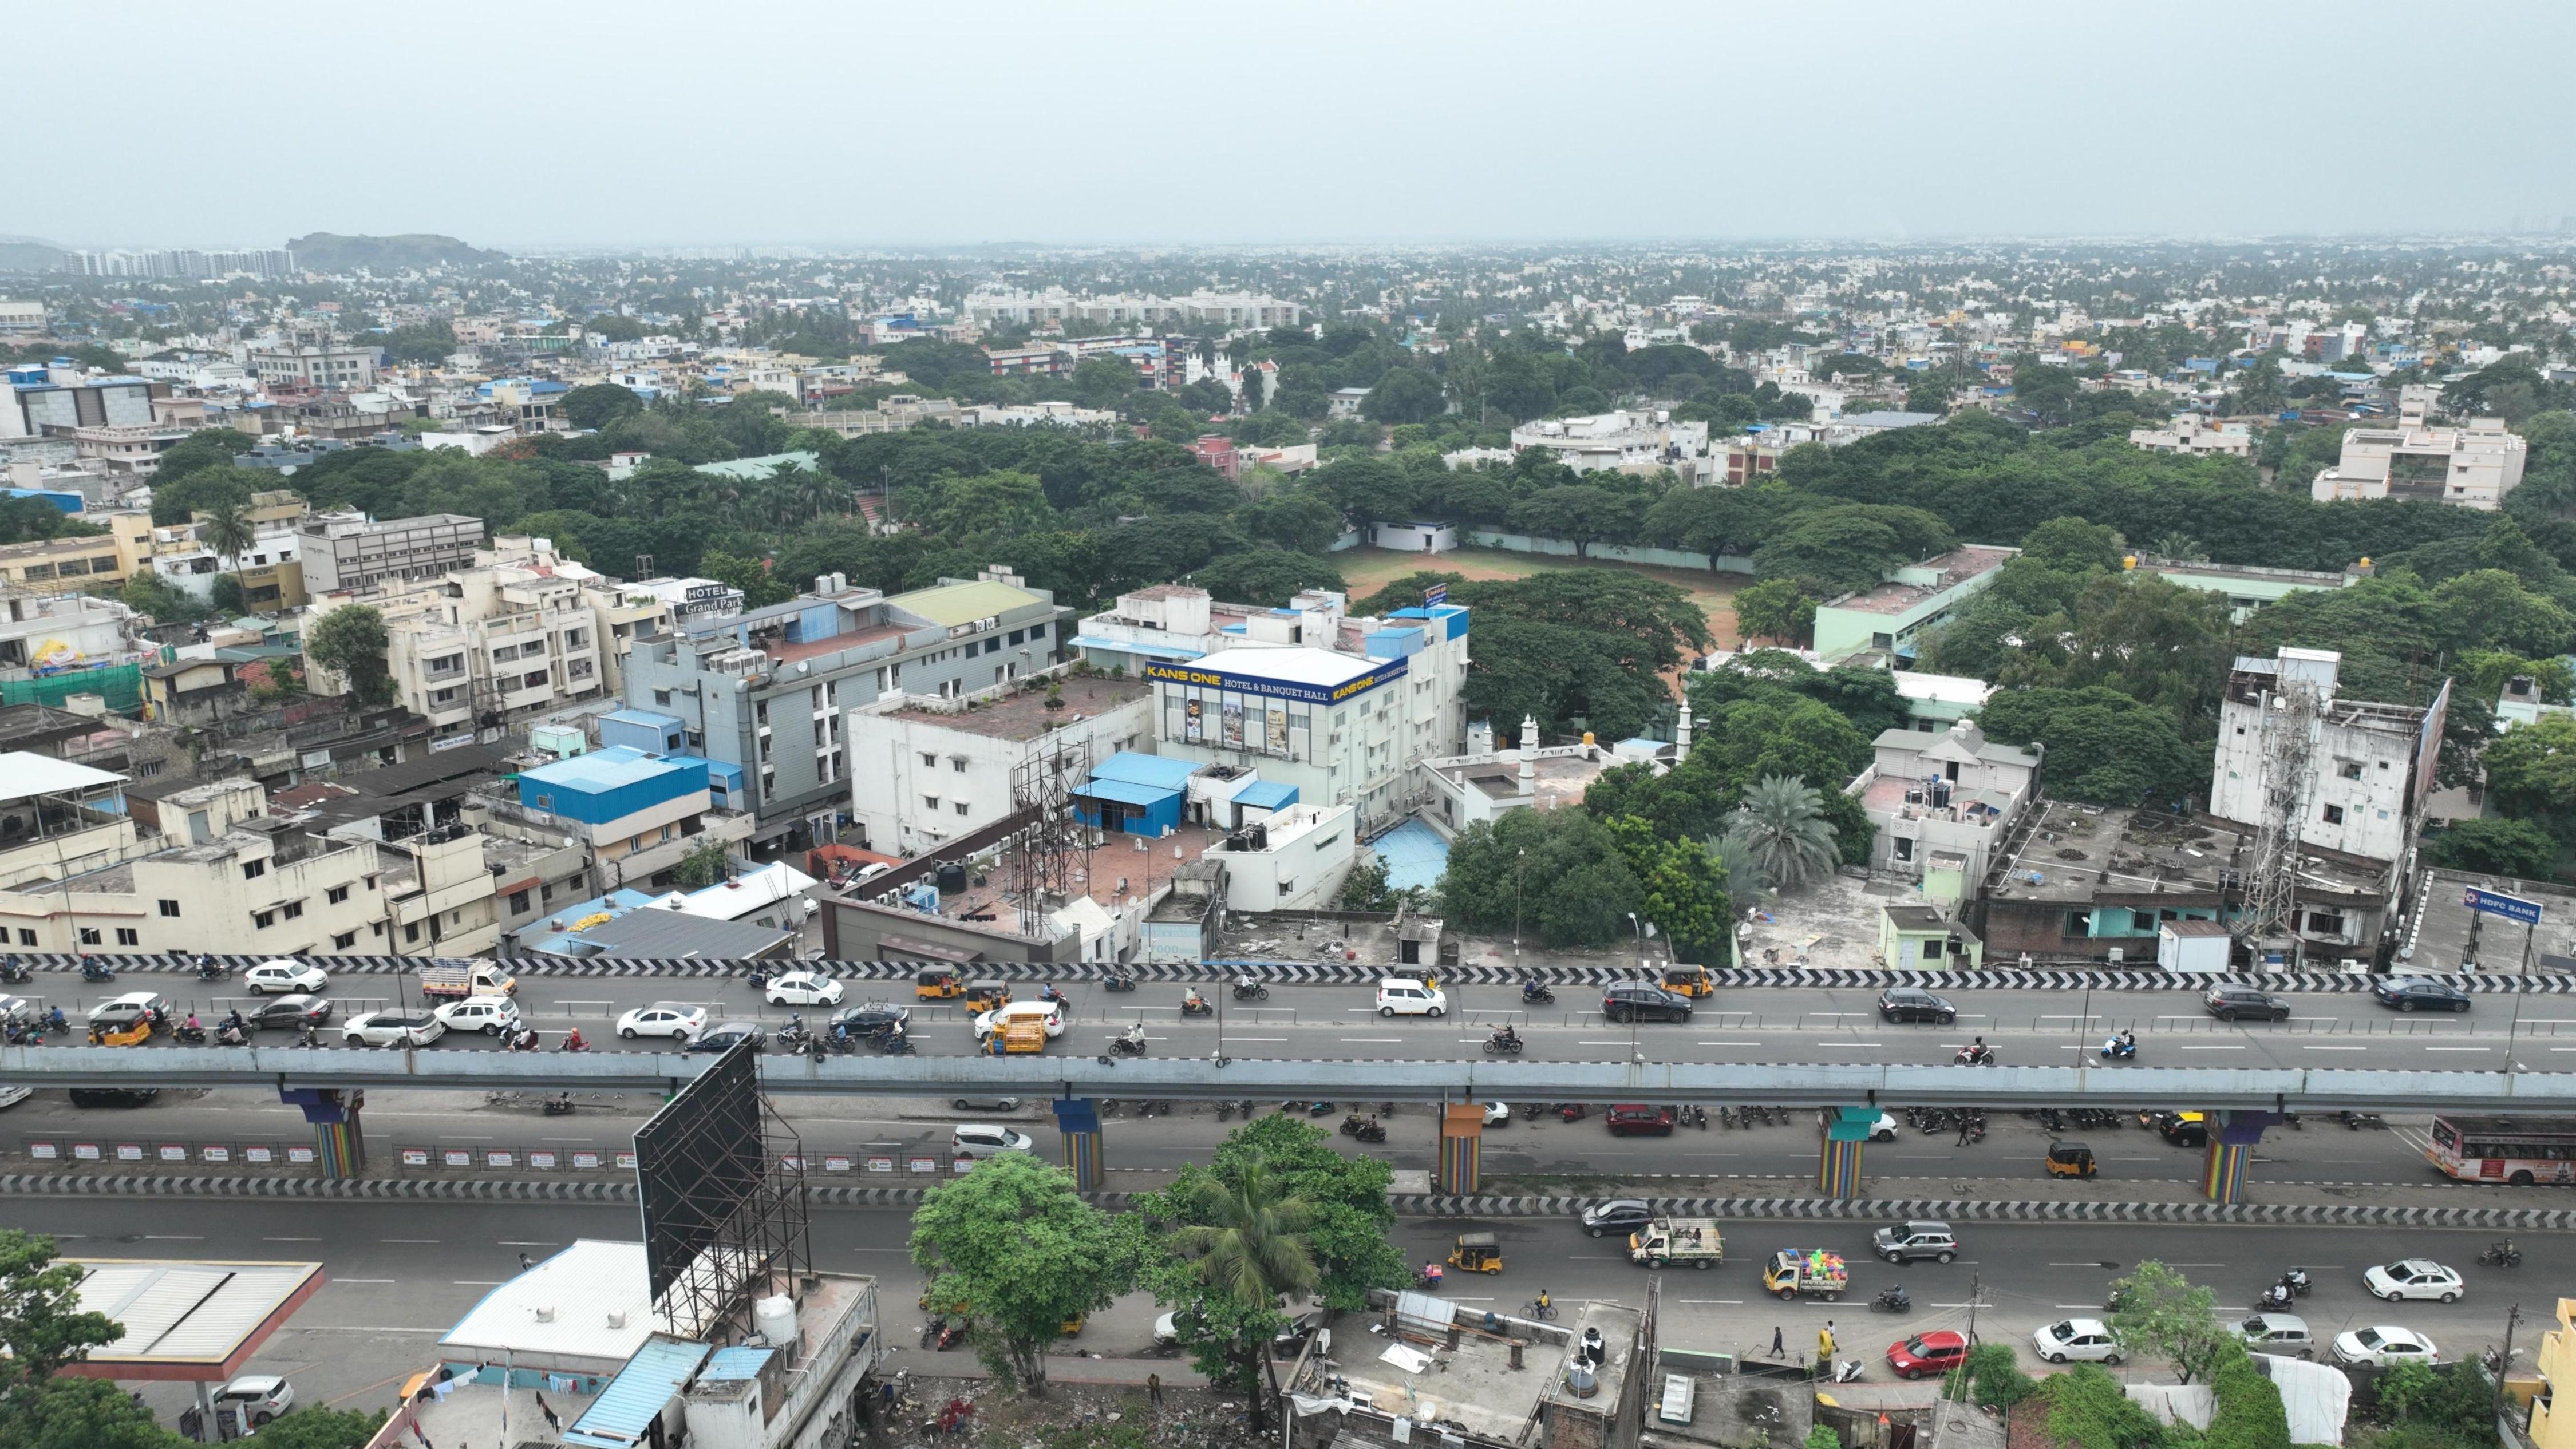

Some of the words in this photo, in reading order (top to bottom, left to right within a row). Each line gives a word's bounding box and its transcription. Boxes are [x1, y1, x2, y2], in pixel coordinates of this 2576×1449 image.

[688, 585, 727, 599] HOTEL
[685, 600, 717, 614] Grand
[720, 597, 744, 609] Park
[1147, 666, 1188, 681] KANS
[1190, 672, 1222, 686] ONE
[1224, 679, 1253, 691] HOTEL
[1254, 683, 1259, 691] &
[1261, 684, 1303, 698] BANQUET
[1304, 689, 1329, 701] HALL
[1333, 683, 1357, 700] KANS
[1357, 676, 1374, 690] ONE
[2480, 897, 2506, 909] HDFC
[2508, 905, 2536, 917] BANK
